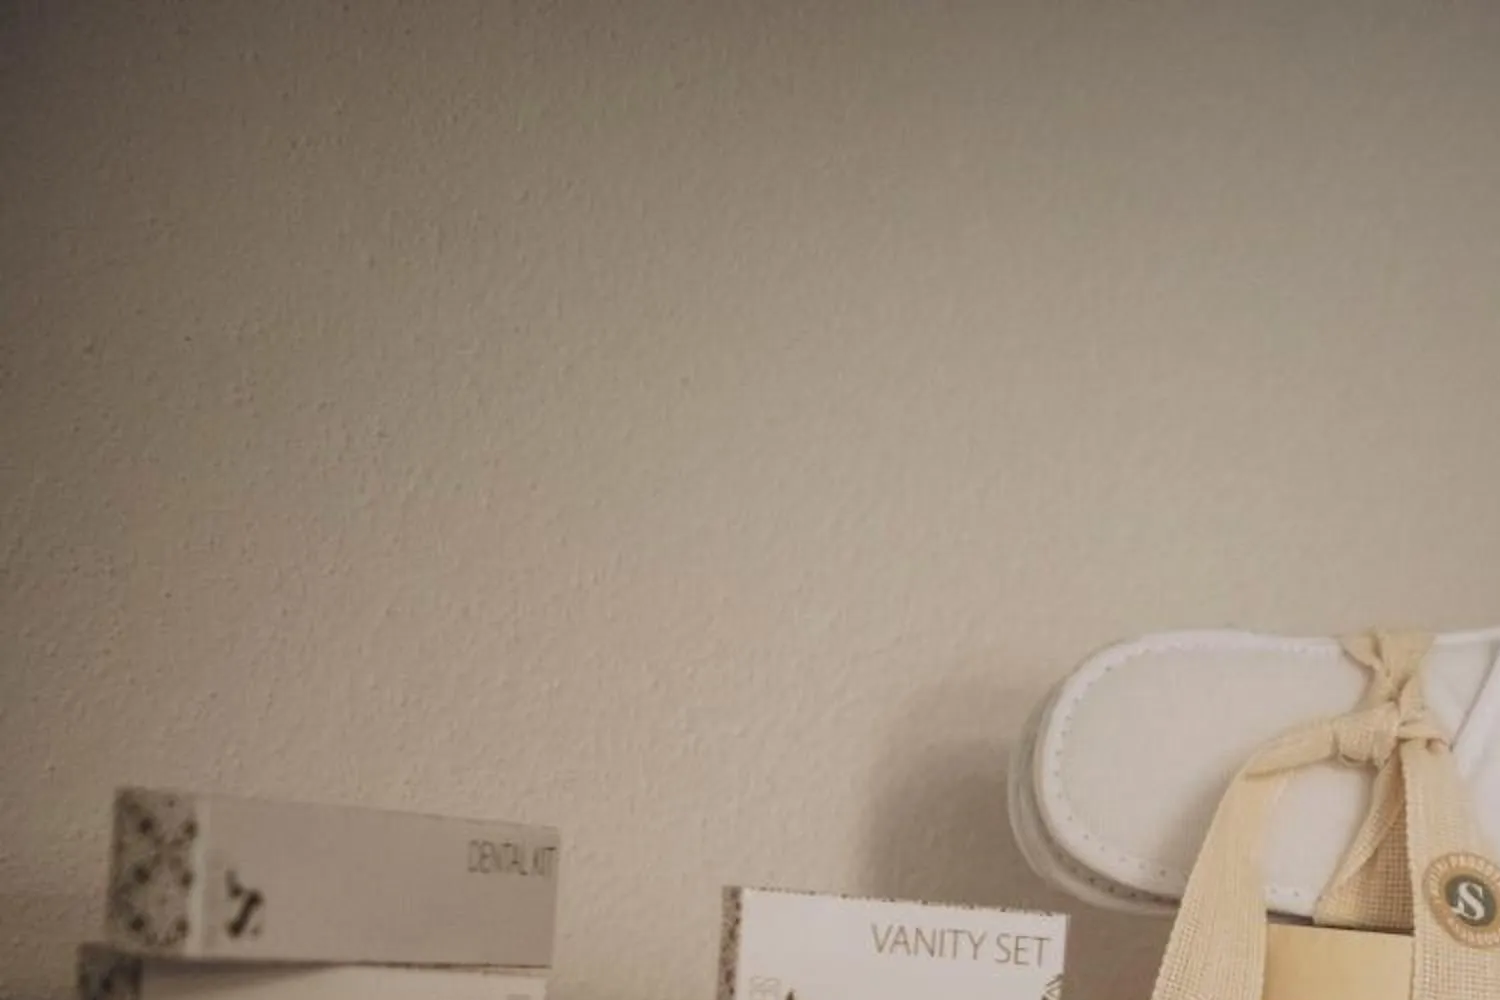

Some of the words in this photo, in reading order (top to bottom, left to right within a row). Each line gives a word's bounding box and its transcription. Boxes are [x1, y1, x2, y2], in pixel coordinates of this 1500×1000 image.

[467, 839, 529, 876] DENTAL
[871, 922, 988, 961] VANITY
[995, 932, 1052, 968] SET
